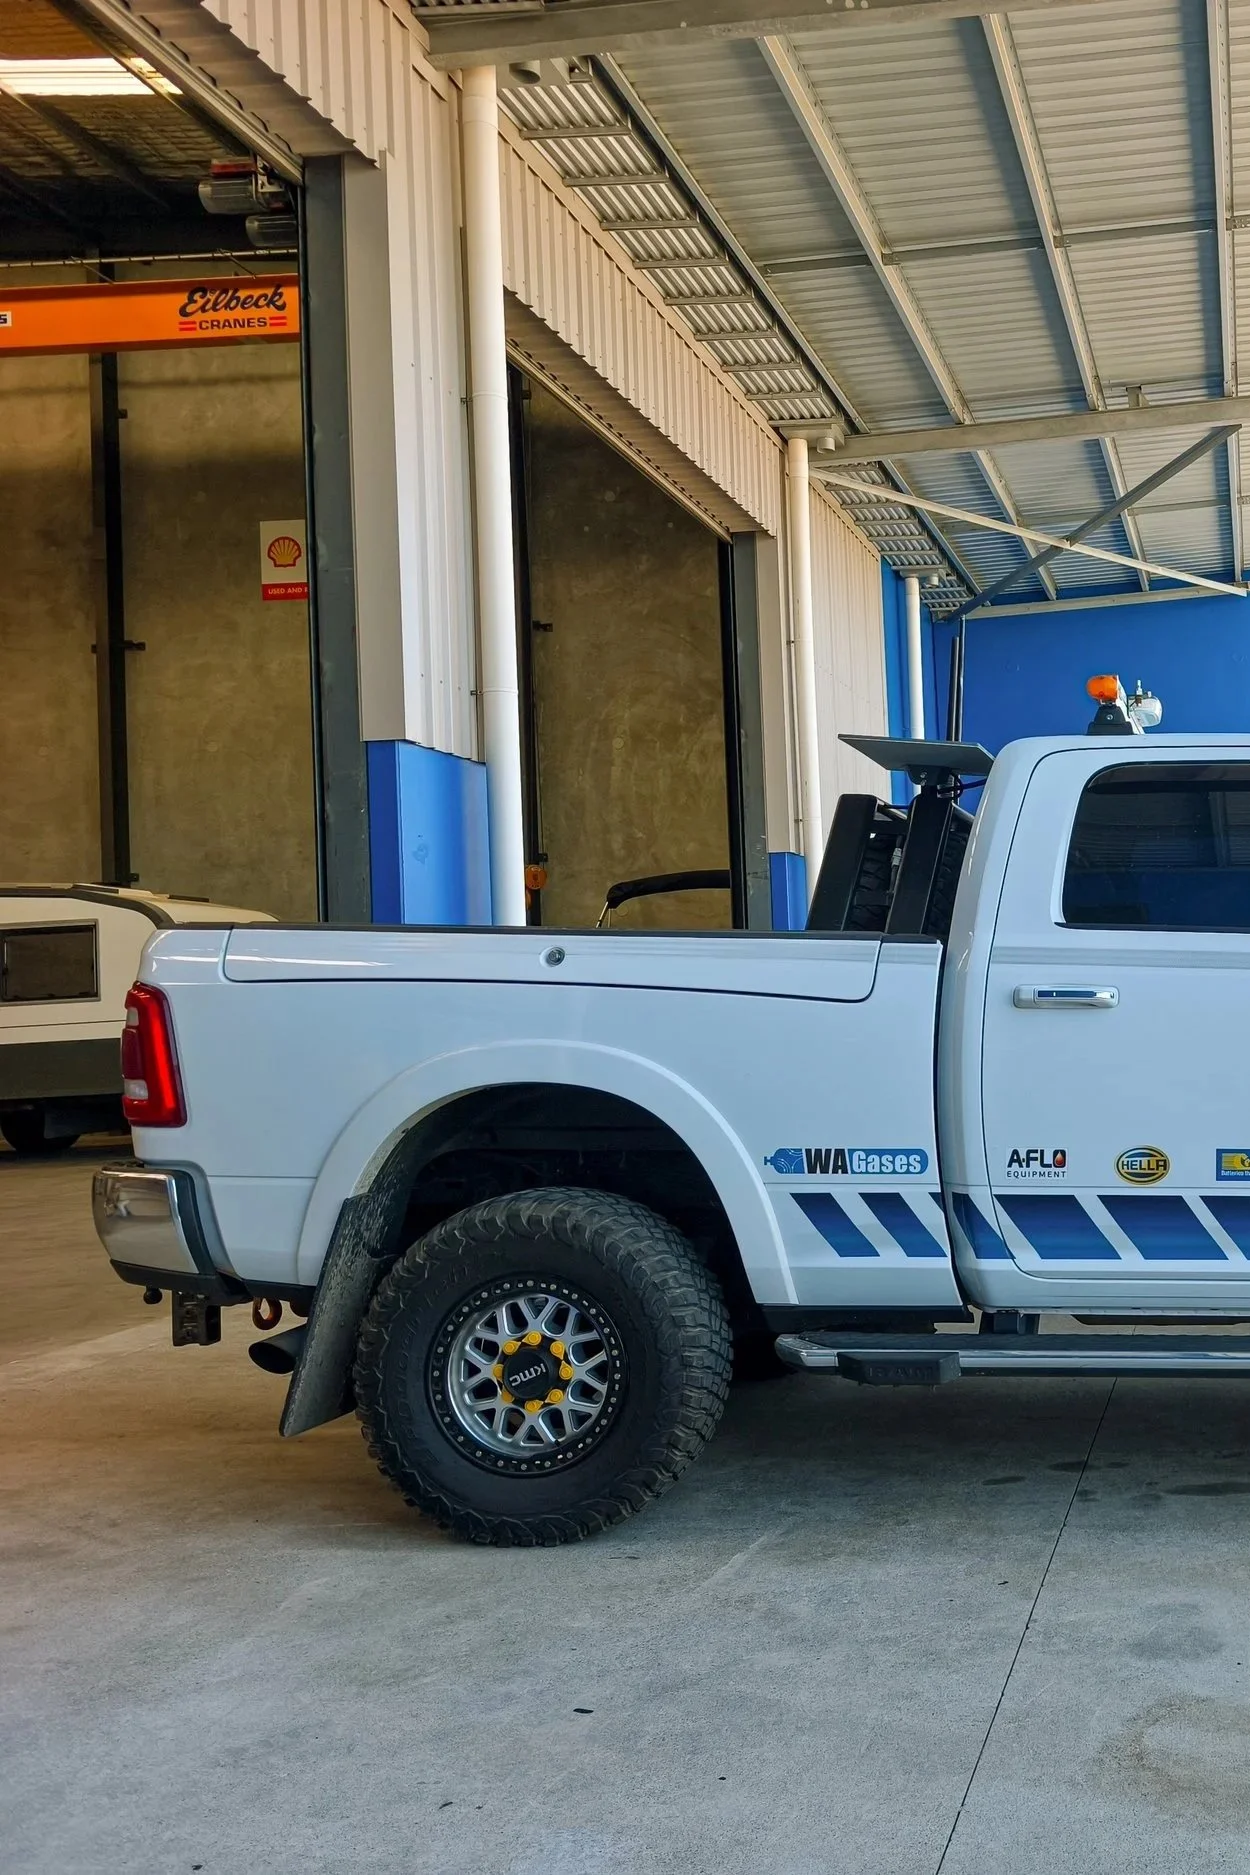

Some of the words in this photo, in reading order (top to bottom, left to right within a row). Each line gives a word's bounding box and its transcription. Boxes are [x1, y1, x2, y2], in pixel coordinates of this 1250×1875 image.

[179, 285, 287, 317] Eilbeck
[198, 317, 268, 331] CRANES
[1121, 1159, 1168, 1171] HELLA
[1006, 1170, 1066, 1178] EQUIPMENT
